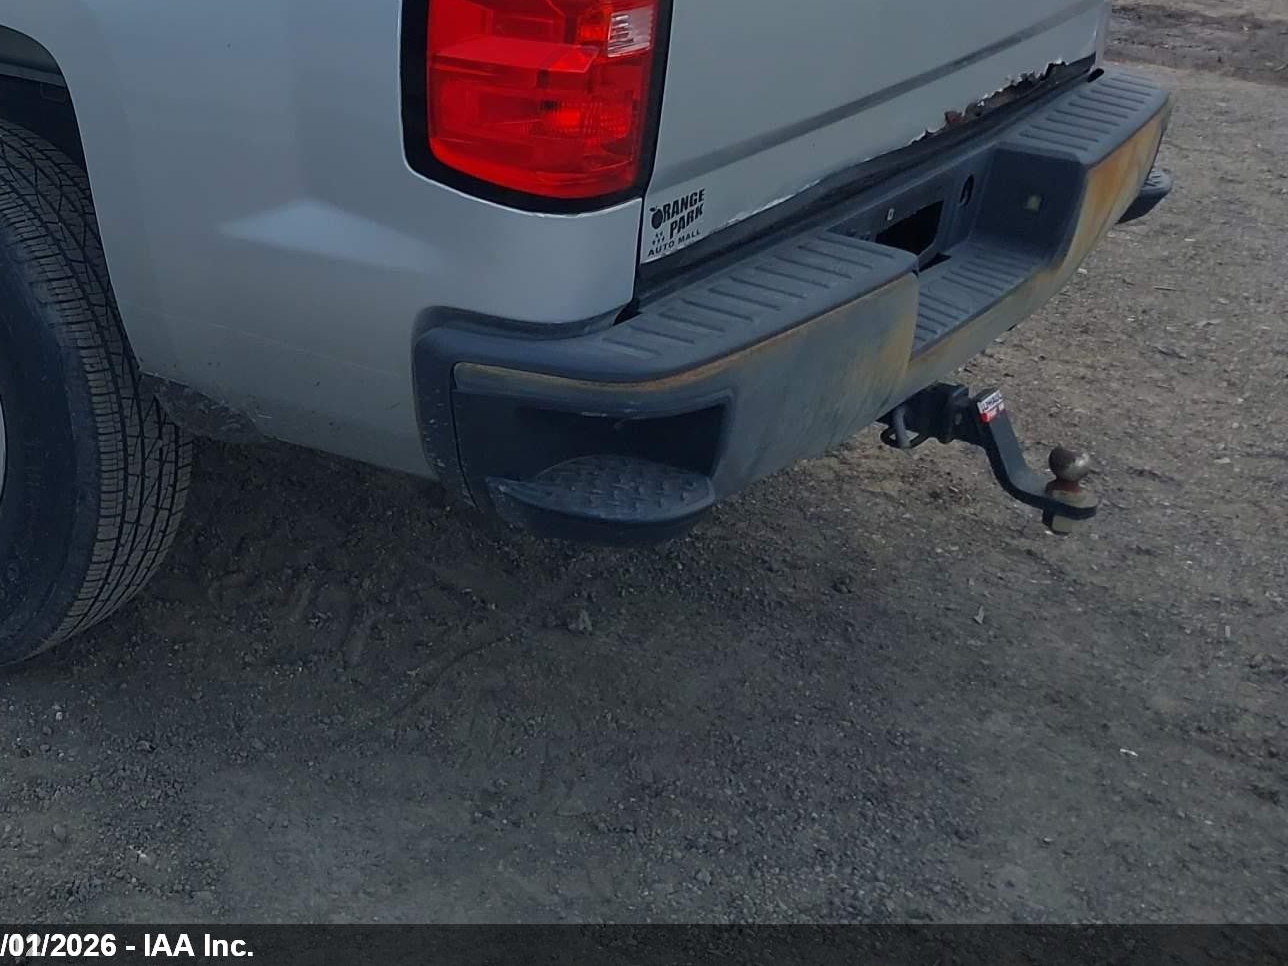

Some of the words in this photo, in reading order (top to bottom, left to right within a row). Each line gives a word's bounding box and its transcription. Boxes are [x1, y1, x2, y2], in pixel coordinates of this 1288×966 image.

[669, 203, 704, 239] PARK
[648, 240, 674, 257] AUTO
[678, 229, 701, 244] MALL
